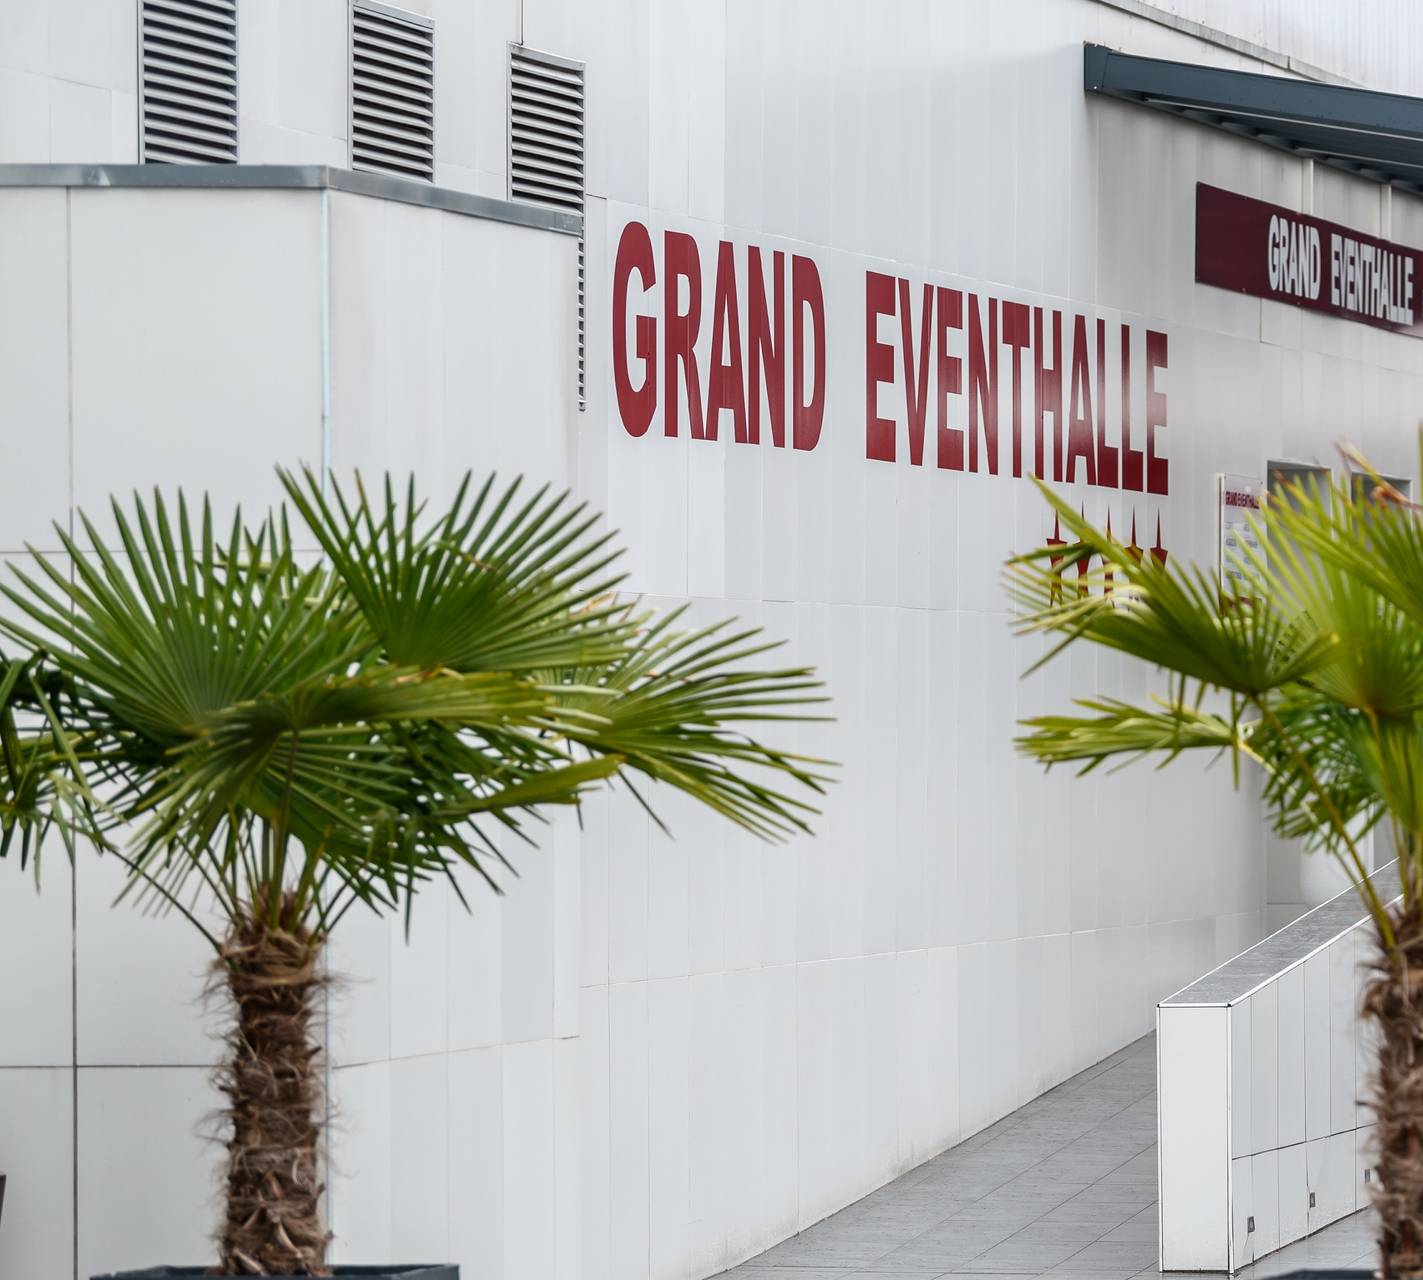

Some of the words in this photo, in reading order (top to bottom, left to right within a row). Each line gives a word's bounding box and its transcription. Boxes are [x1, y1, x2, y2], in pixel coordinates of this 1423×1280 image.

[612, 221, 826, 452] GRAND
[866, 270, 1169, 495] EVENTHALLE
[1268, 214, 1321, 300] GRAND
[1331, 233, 1413, 326] EVENTHALLE
